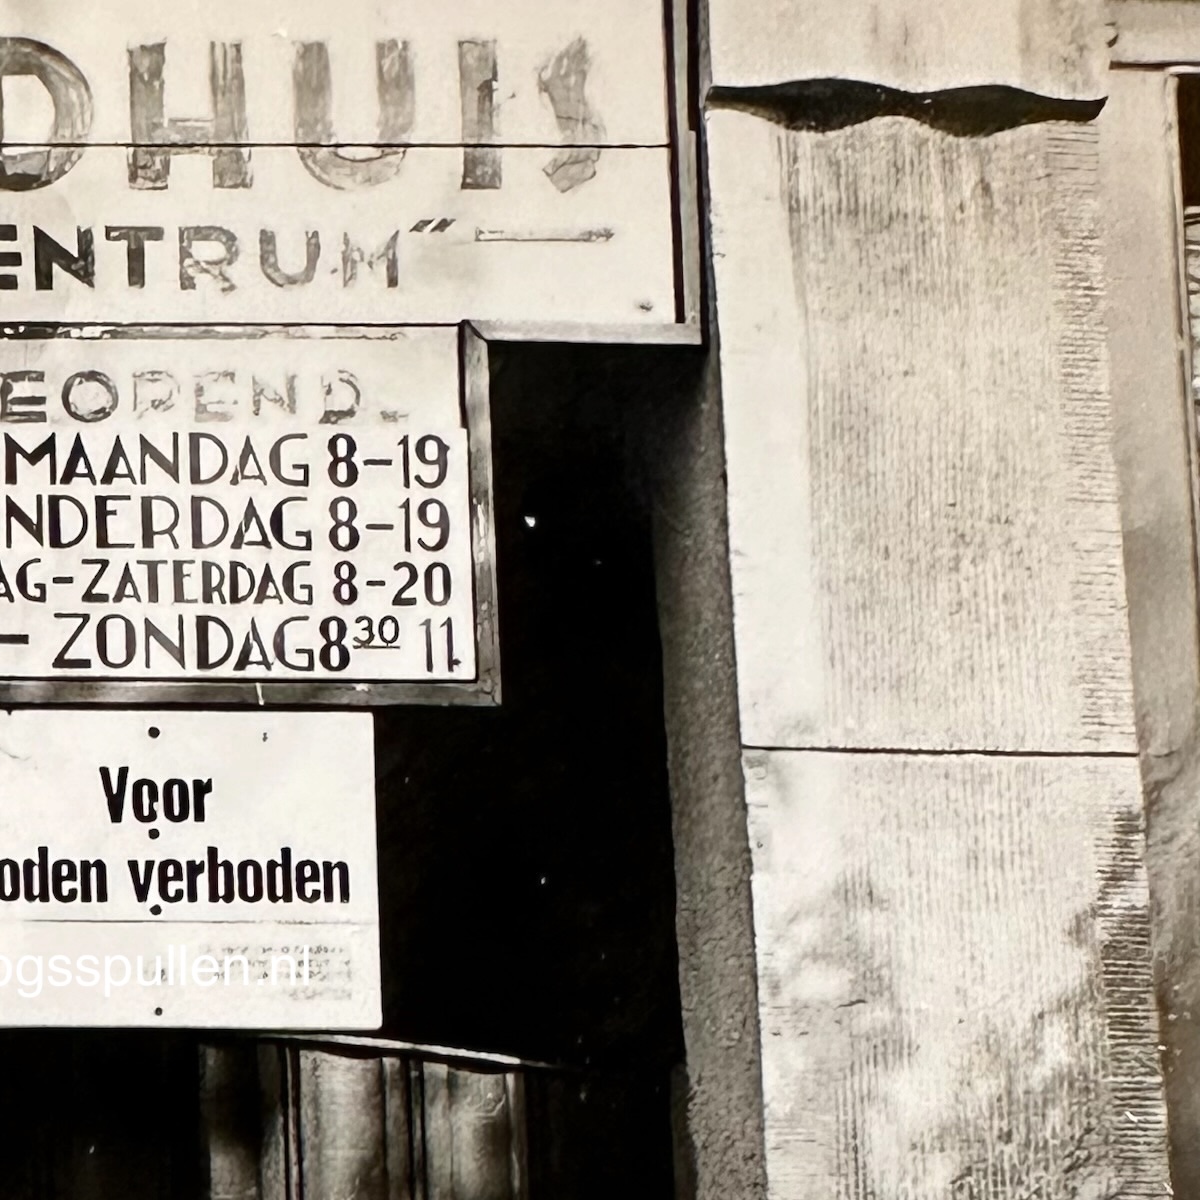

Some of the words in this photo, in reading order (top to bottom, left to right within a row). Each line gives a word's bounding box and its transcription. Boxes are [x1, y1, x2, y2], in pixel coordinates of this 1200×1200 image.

[3, 431, 310, 487] MAANDAG
[52, 612, 314, 671] ZONDAG
[418, 616, 462, 673] 11
[99, 765, 213, 824] Voor
[128, 845, 351, 904] verboden
